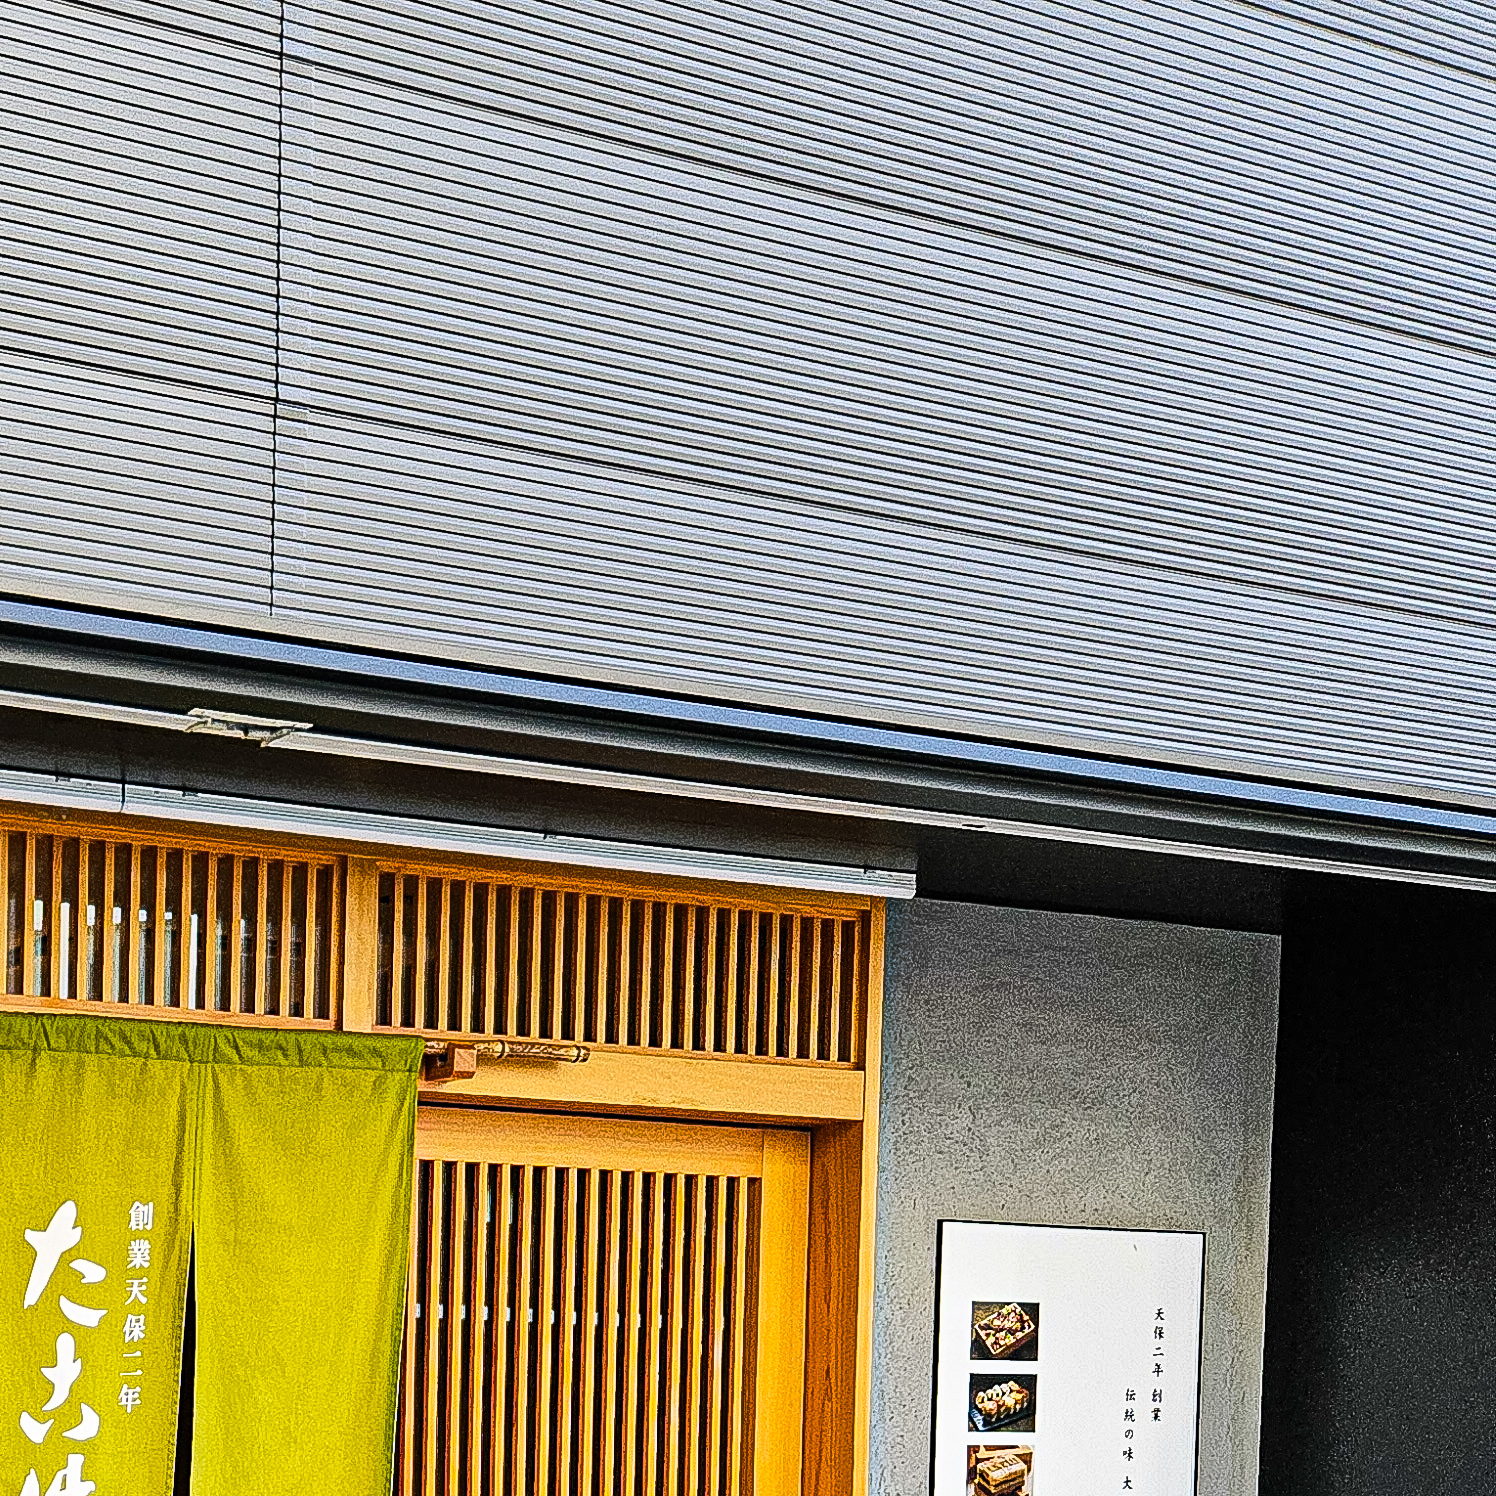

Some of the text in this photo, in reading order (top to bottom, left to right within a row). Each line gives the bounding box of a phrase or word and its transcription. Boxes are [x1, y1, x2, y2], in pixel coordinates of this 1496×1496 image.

[118, 1201, 154, 1414] 創業天保二年
[1122, 1387, 1137, 1462] 伝統の味
